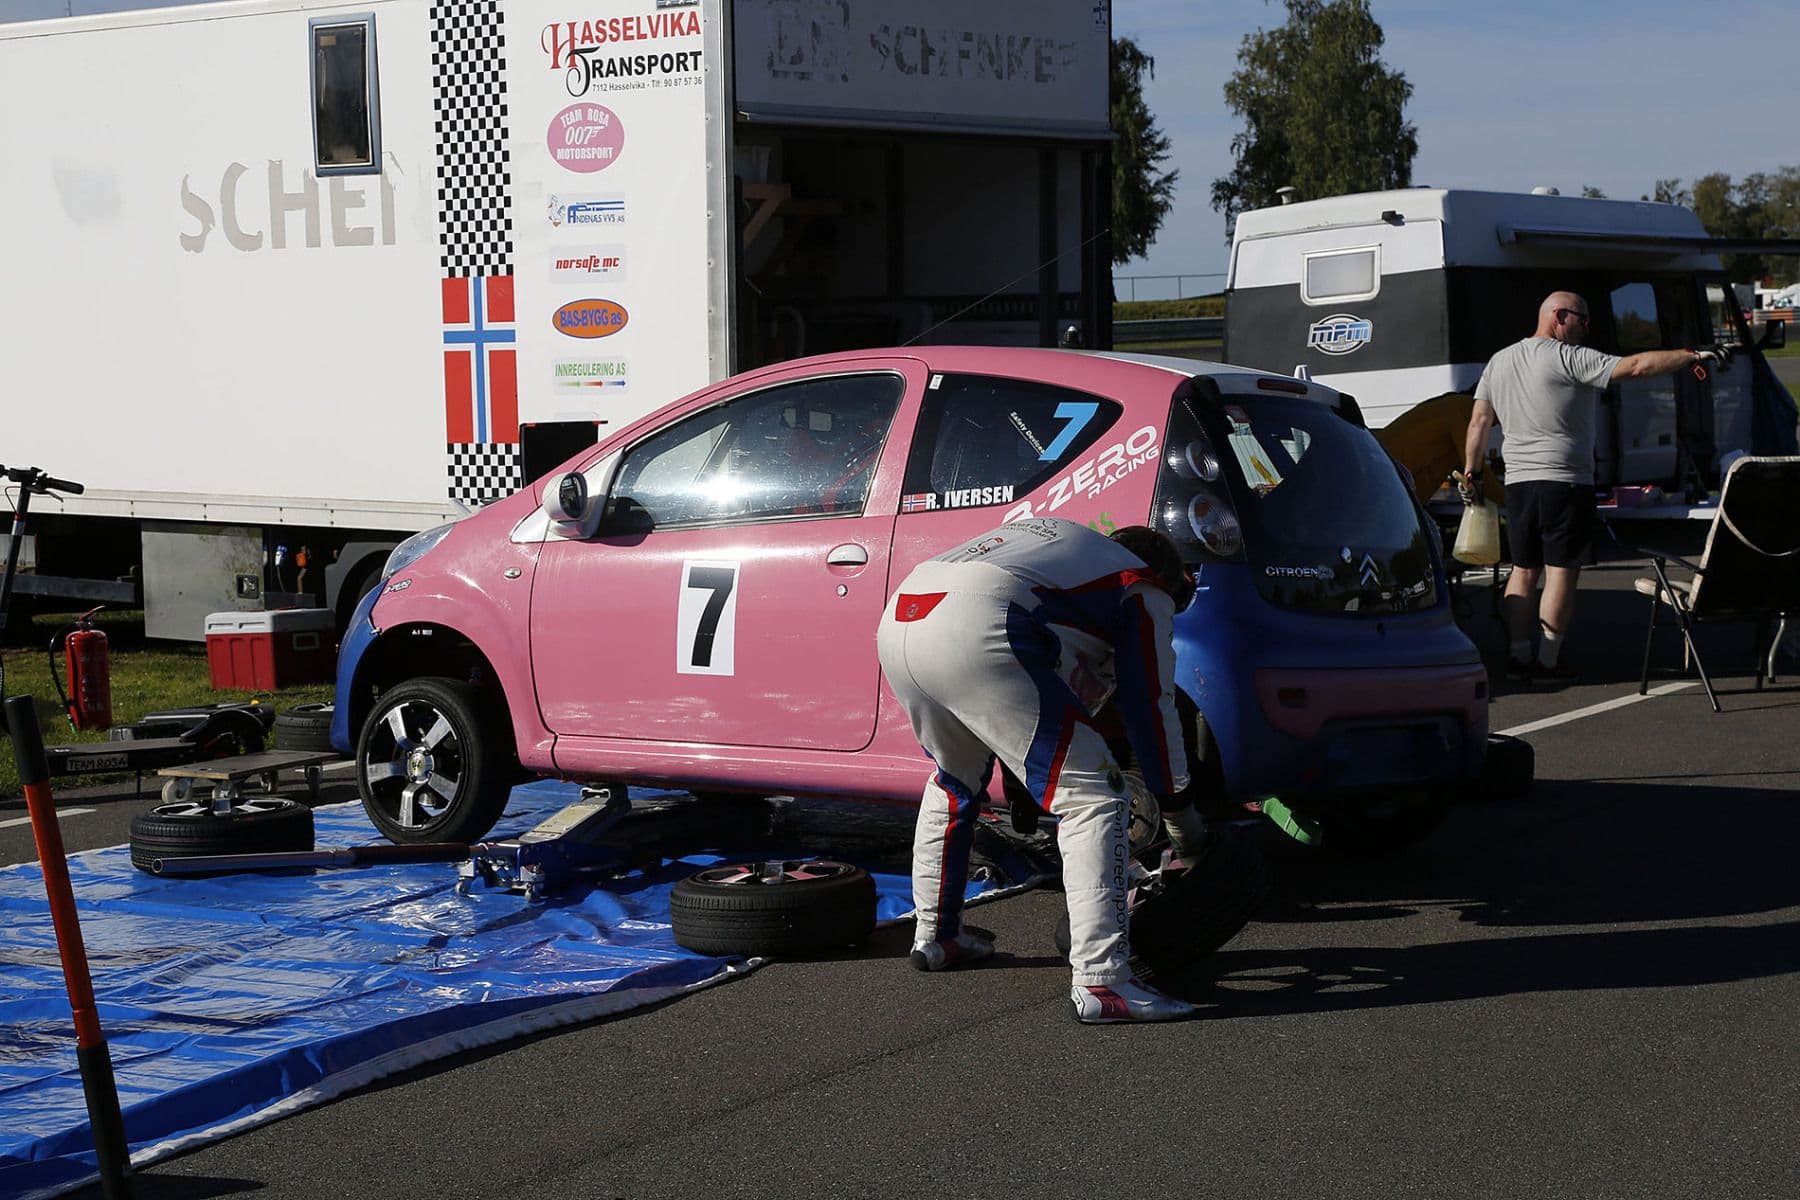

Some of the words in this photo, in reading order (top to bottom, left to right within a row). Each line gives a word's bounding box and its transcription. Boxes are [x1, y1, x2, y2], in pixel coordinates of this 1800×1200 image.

[541, 11, 701, 69] HASSELVIKA
[565, 45, 702, 97] TRANSPORT
[592, 83, 608, 92] 7112
[609, 81, 646, 91] Hasselvika
[663, 78, 673, 87] 90
[673, 77, 682, 86] 87
[684, 77, 692, 86] 57
[560, 109, 582, 128] TEAM
[587, 108, 610, 127] ROSA
[565, 125, 594, 145] 007
[557, 146, 613, 160] MOTORSPORT
[603, 213, 616, 223] VVS
[555, 255, 600, 273] norsafe
[602, 257, 620, 268] mc
[559, 309, 609, 328] BAS-BYGG
[610, 311, 622, 325] as
[555, 362, 614, 377] INNREGULERING
[615, 362, 626, 376] AS
[1039, 402, 1100, 461] 7
[1088, 444, 1160, 500] RACING
[926, 492, 941, 510] R.
[944, 485, 1014, 508] IVERSEN
[687, 567, 736, 667] 7
[68, 759, 95, 770] TEAM
[96, 757, 126, 769] ROSA
